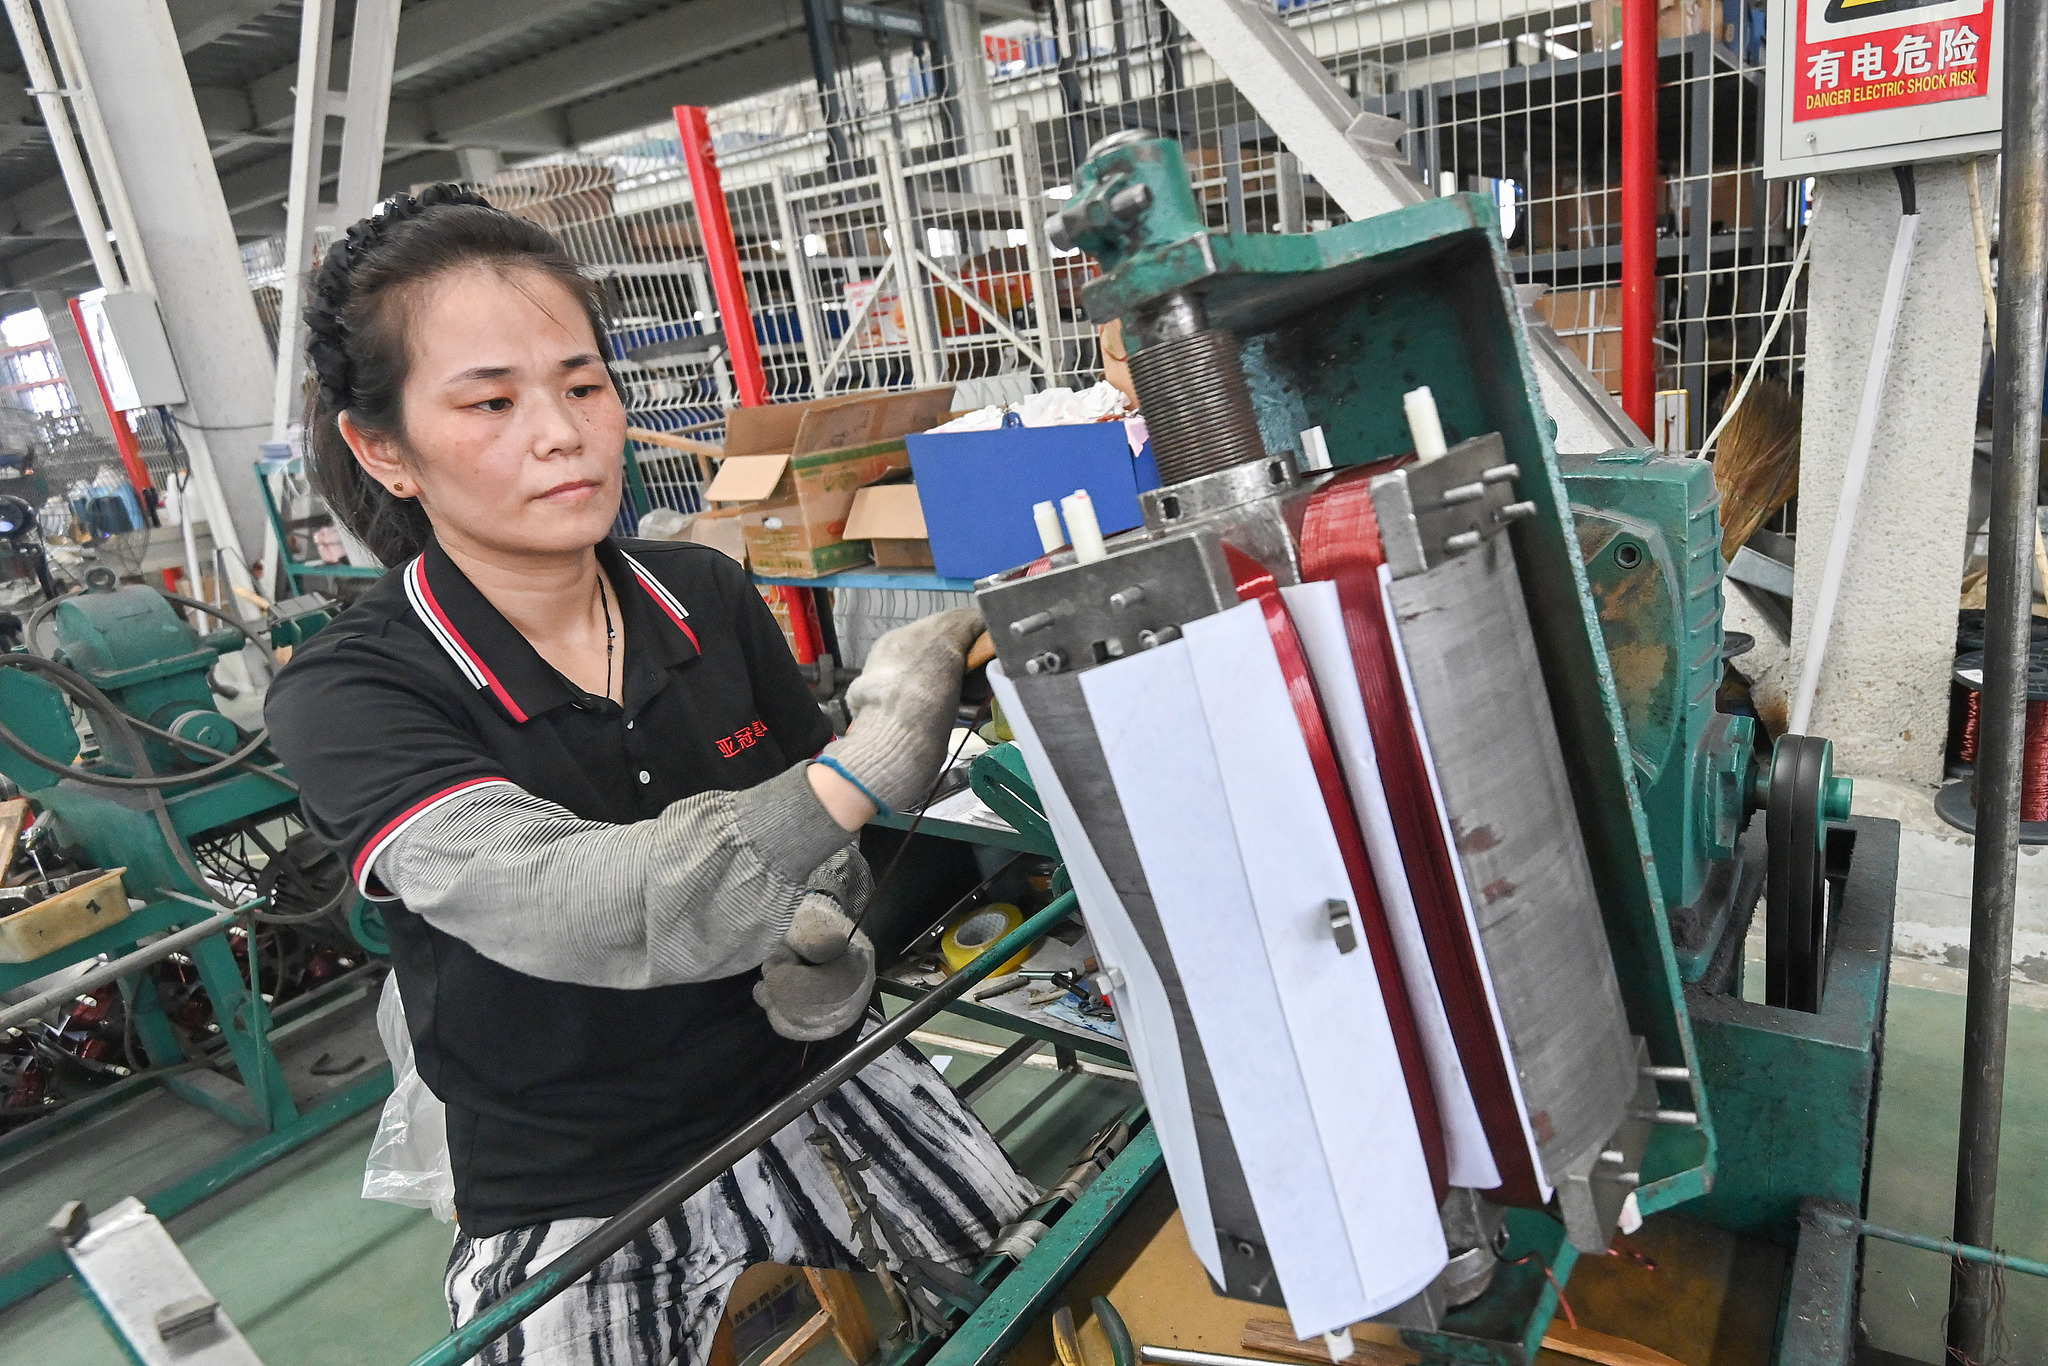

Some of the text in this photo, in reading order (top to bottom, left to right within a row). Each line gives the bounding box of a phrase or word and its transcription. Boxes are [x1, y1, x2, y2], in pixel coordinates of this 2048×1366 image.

[1806, 25, 1980, 91] 有电危险
[1806, 68, 1977, 110] DANGER ELECTRIC SHOCK RISK
